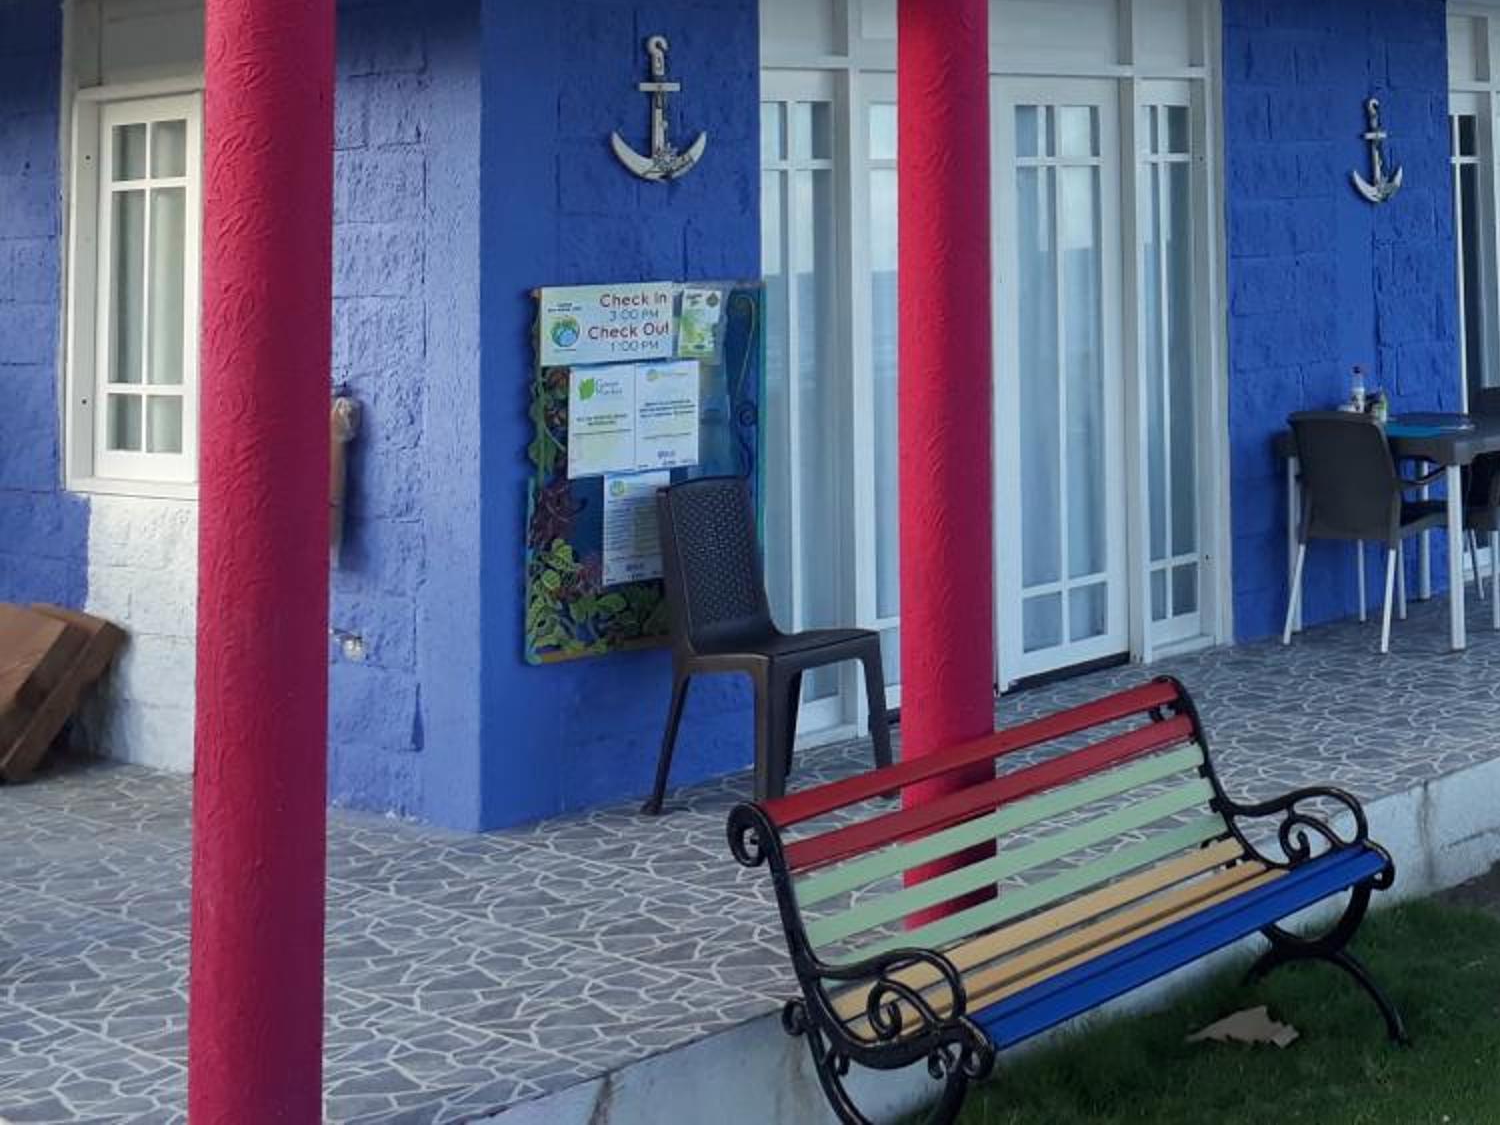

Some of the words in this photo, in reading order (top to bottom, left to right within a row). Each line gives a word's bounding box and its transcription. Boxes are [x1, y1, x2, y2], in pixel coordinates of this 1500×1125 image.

[599, 293, 649, 307] Check
[654, 293, 667, 306] In
[642, 309, 659, 320] PM
[588, 326, 639, 340] Check
[643, 322, 669, 337] Out
[611, 341, 638, 352] 1:00
[642, 340, 659, 351] PM
